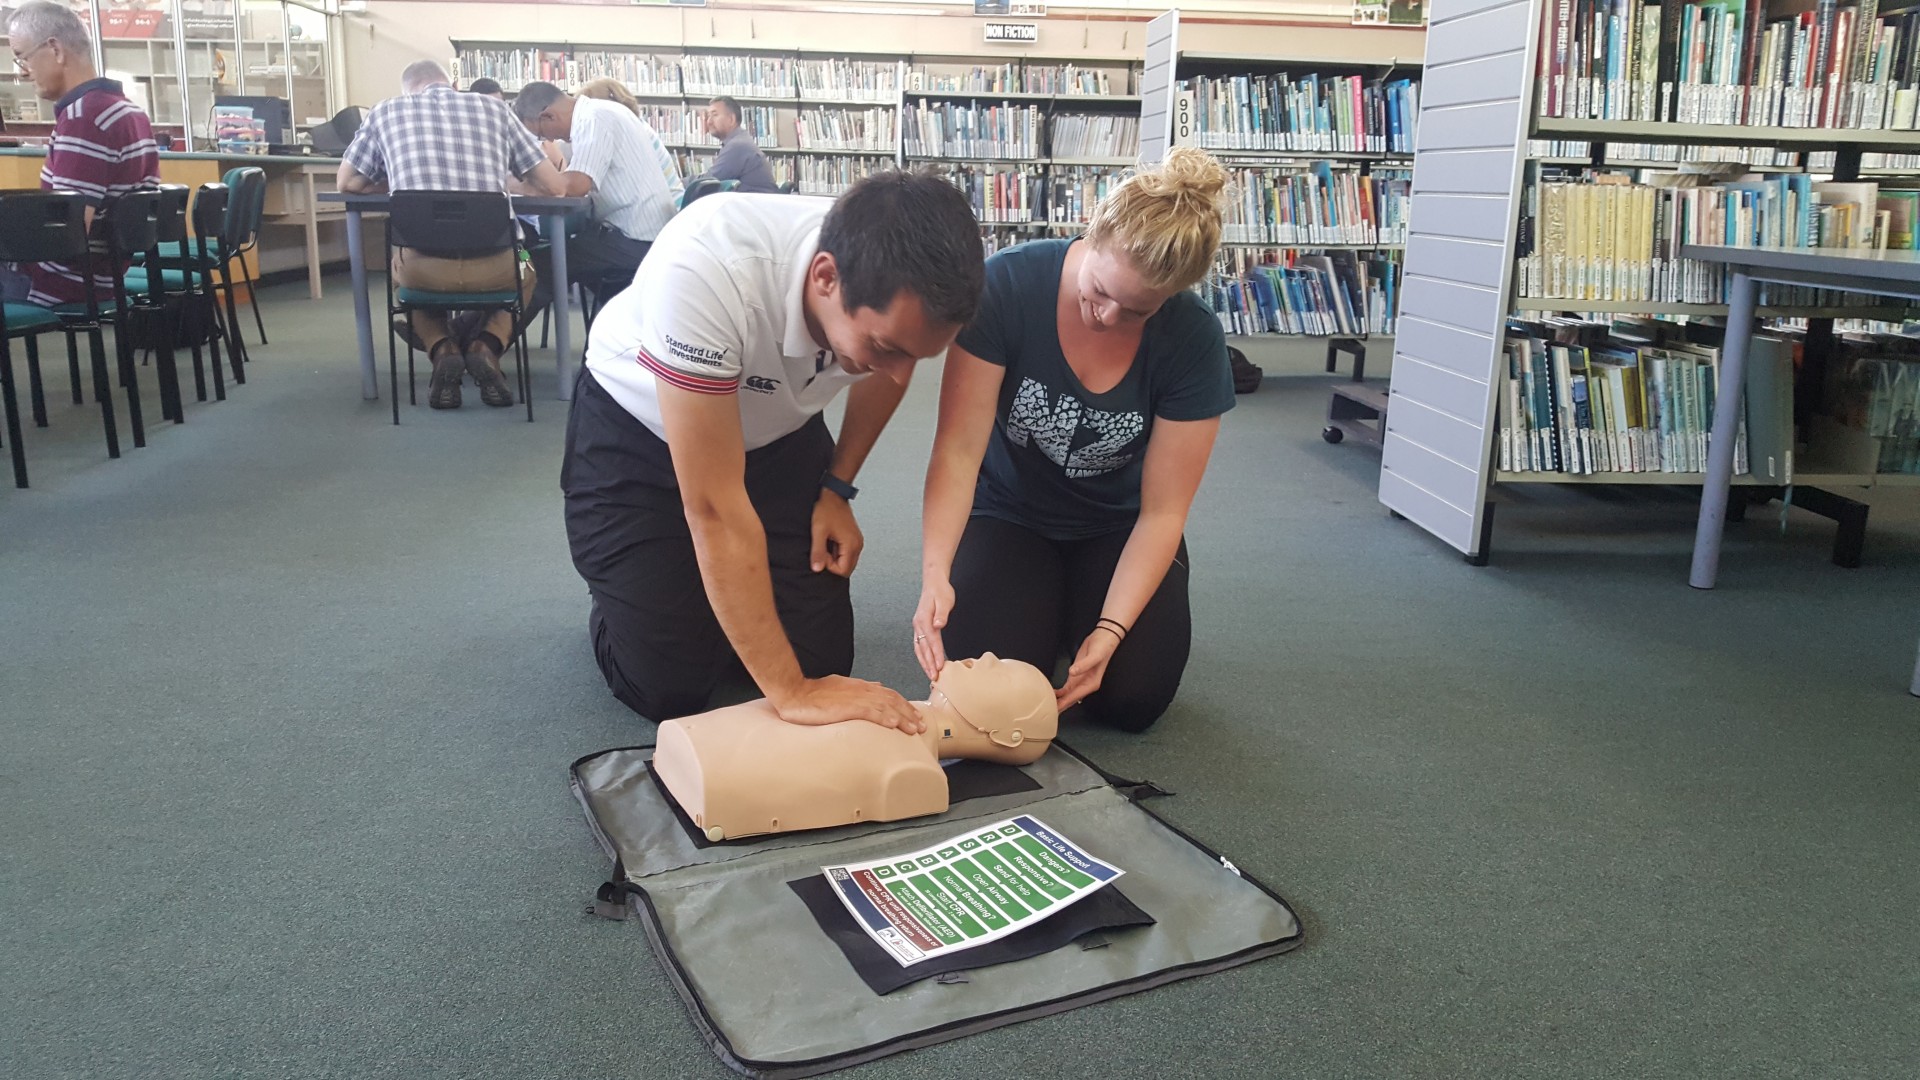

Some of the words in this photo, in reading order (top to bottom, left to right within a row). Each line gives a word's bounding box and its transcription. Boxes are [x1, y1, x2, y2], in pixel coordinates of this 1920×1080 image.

[986, 24, 1004, 39] NON
[1004, 25, 1035, 39] FICTION
[1179, 98, 1189, 138] 900
[665, 334, 706, 356] Standard
[705, 349, 724, 361] Life
[668, 345, 723, 368] Investments
[963, 841, 975, 849] S
[982, 833, 996, 842] R
[1036, 830, 1055, 844] Basic
[1052, 842, 1066, 853] Life
[1064, 851, 1091, 869] Support
[900, 863, 912, 871] C
[921, 857, 934, 865] B
[941, 850, 954, 858] A
[1039, 851, 1071, 874] Dangers?
[879, 868, 891, 876] D
[993, 864, 1012, 879] Send
[1009, 877, 1019, 885] for
[1016, 884, 1031, 896] help
[1013, 855, 1054, 887] Responsive?
[943, 875, 966, 893] Normal
[962, 891, 997, 920] Breathing?
[972, 873, 989, 888] Open
[987, 886, 1010, 905] Airway
[863, 871, 882, 892] Continue
[880, 891, 893, 903] CPR
[889, 901, 902, 913] until
[899, 911, 933, 943] responsiveness
[866, 888, 884, 905] normal
[880, 903, 902, 925] breathing
[899, 922, 915, 937] return
[899, 887, 915, 901] Attach
[913, 900, 941, 926] Defibrillator
[938, 924, 956, 938] (AED)
[936, 892, 952, 905] Start
[949, 903, 966, 917] CPR
